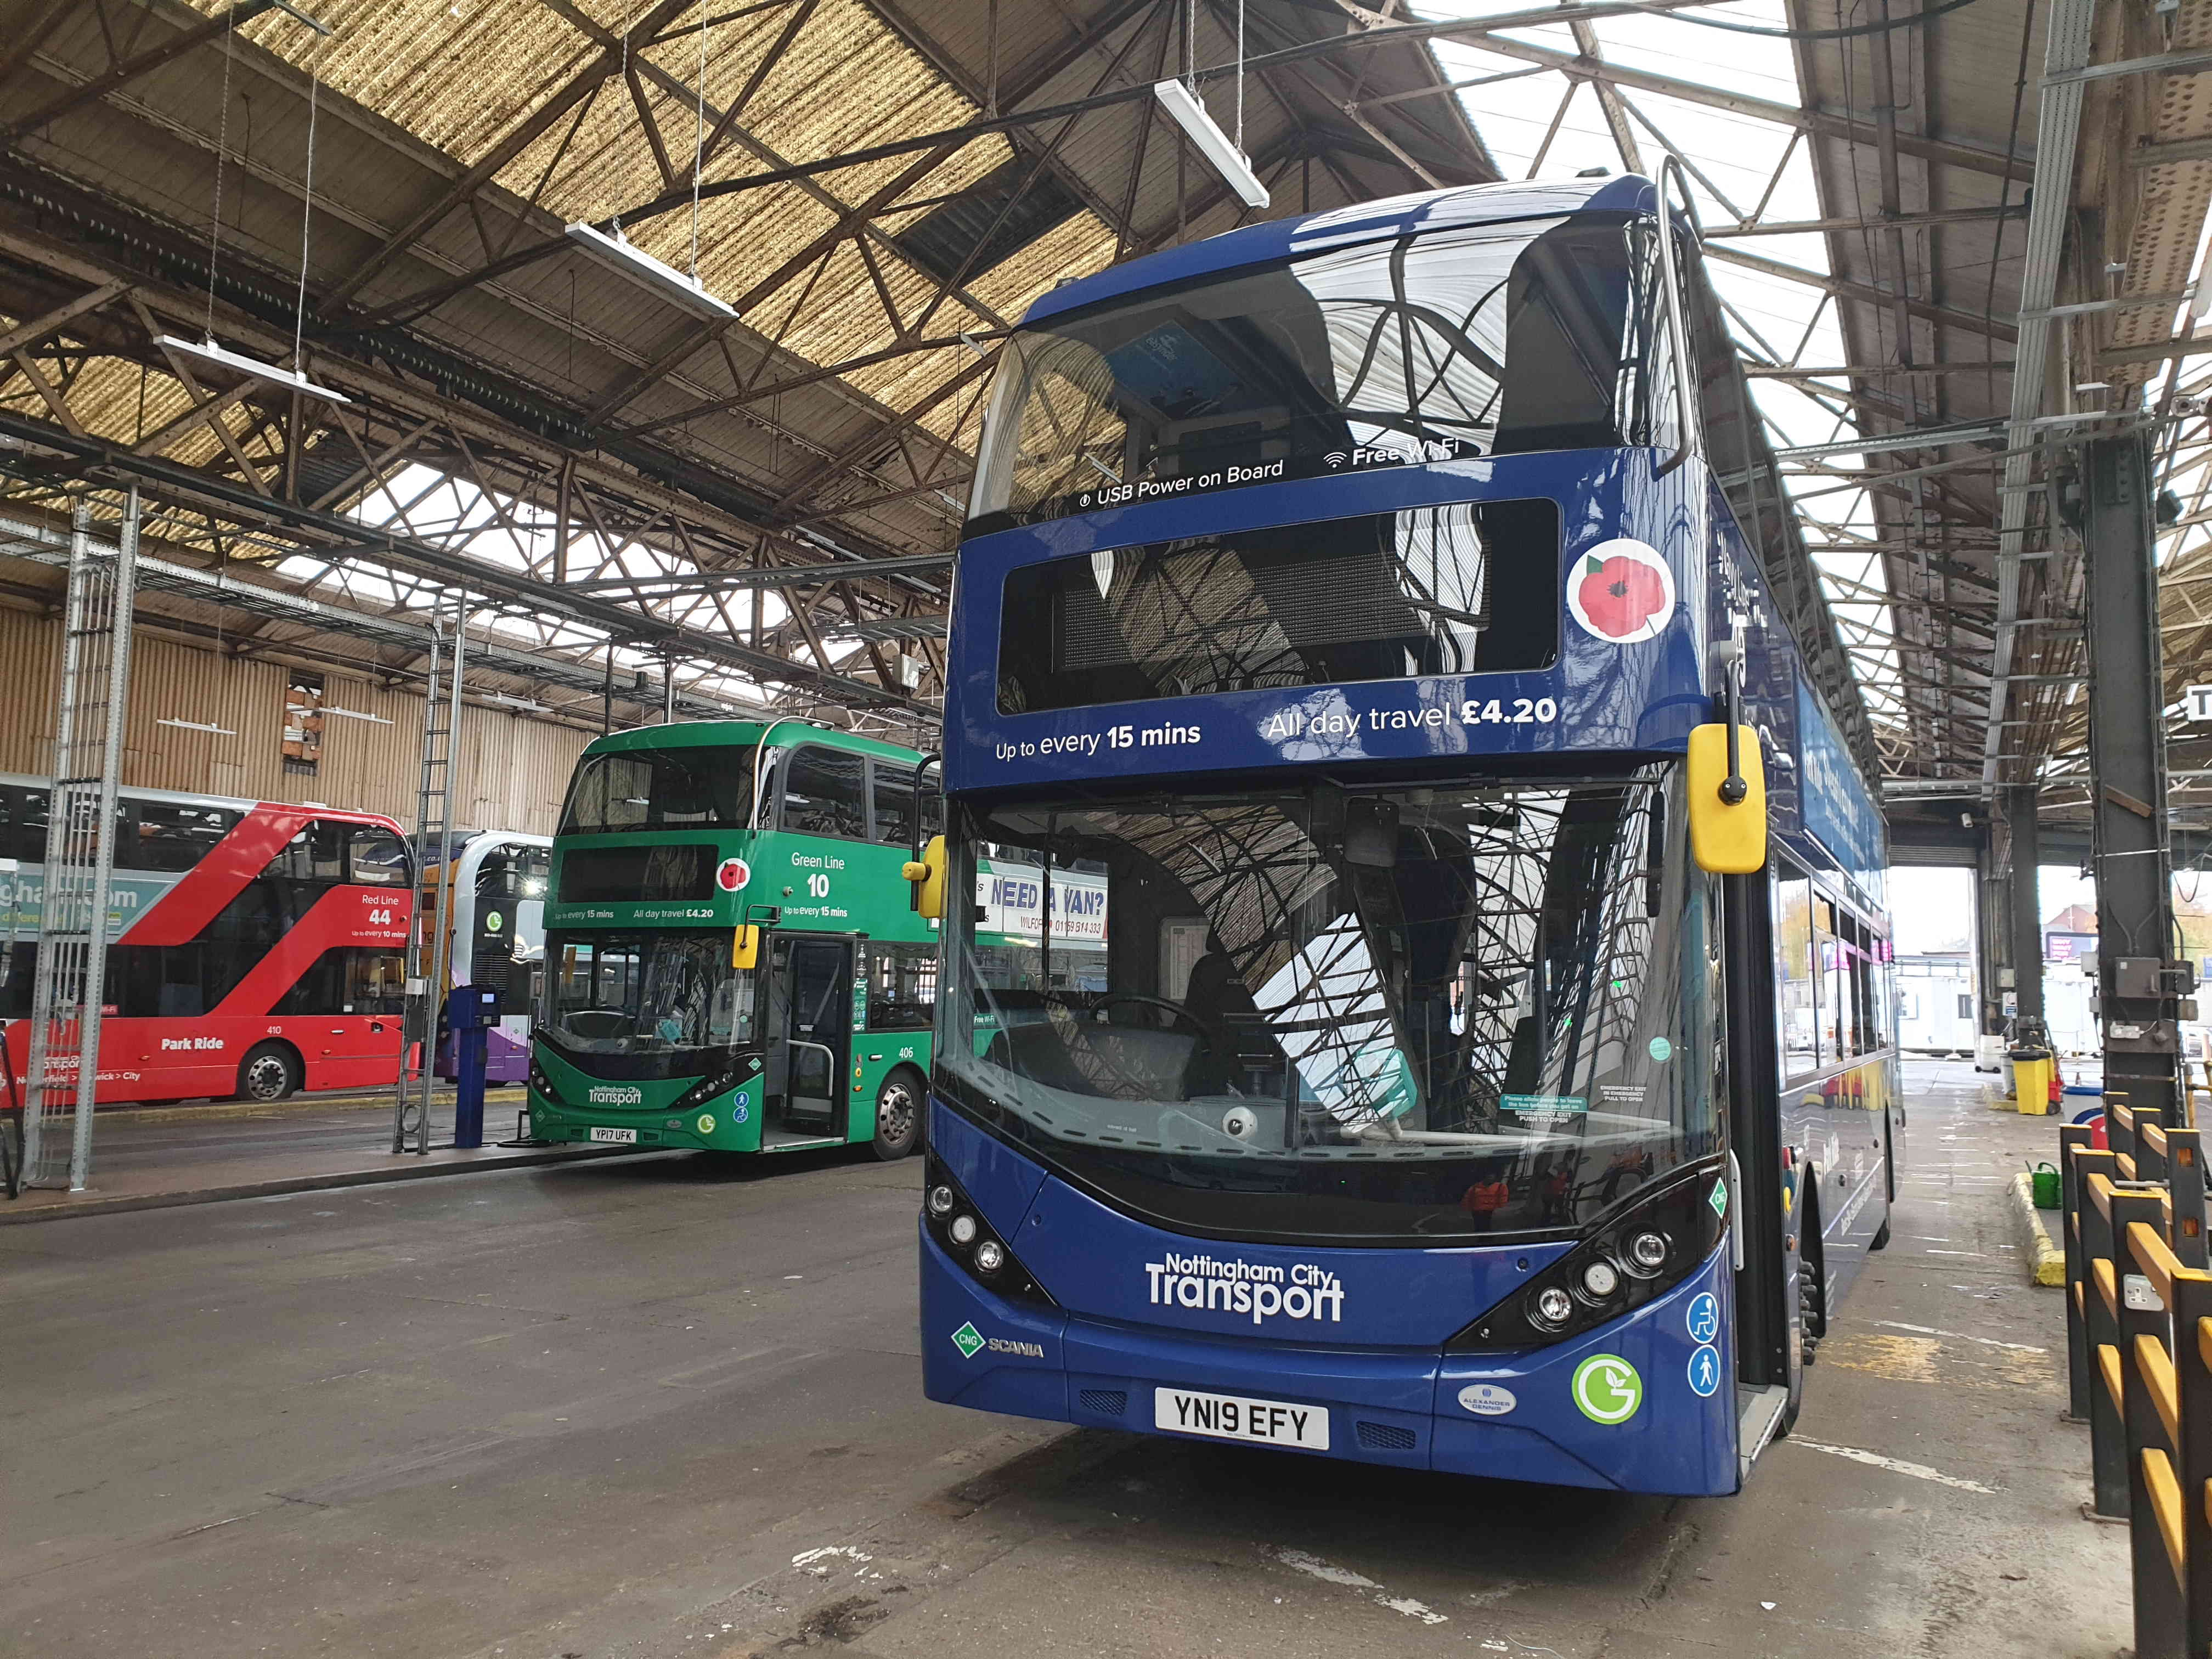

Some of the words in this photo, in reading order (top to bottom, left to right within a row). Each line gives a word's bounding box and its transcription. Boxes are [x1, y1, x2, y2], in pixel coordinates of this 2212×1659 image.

[1353, 447, 1400, 466] Free
[1407, 438, 1460, 457] Wi-Fi
[1097, 486, 1132, 505] USB
[1138, 476, 1194, 498] Power
[1199, 474, 1220, 487] on
[1227, 460, 1283, 484] Board
[1268, 714, 1300, 737] All
[1311, 710, 1359, 738] day
[1369, 702, 1451, 730] travel
[1461, 698, 1557, 725] £4.20
[996, 742, 1016, 762] Up
[1021, 742, 1035, 757] to
[1041, 733, 1101, 756] every
[1107, 725, 1133, 748] 15
[1142, 721, 1200, 746] mins
[792, 852, 822, 867] Green
[825, 855, 844, 869] Line
[808, 873, 829, 898] 10
[362, 895, 379, 904] Red
[381, 895, 399, 905] Line
[991, 879, 1037, 909] NEED
[1065, 889, 1104, 916] VAN?
[369, 909, 391, 925] 44
[568, 912, 586, 920] every
[596, 910, 614, 918] mins
[634, 910, 644, 918] All
[646, 911, 659, 919] day
[662, 909, 685, 917] travel
[686, 909, 714, 918] £4.20
[785, 906, 793, 915] Up
[800, 907, 820, 918] every
[821, 906, 829, 916] 15
[831, 907, 848, 917] mins
[1090, 923, 1101, 934] 333
[267, 1026, 281, 1034] 410
[161, 1038, 191, 1050] Park
[195, 1037, 224, 1049] Ride
[899, 1047, 913, 1059] 406
[122, 1072, 140, 1081] City
[589, 1089, 642, 1106] Transport
[594, 1086, 626, 1094] Nottingham
[596, 1129, 614, 1139] YP17
[616, 1130, 631, 1141] UFK
[1166, 1253, 1285, 1283] Nottingham
[1291, 1264, 1334, 1290] City
[1146, 1263, 1344, 1324] Transport
[959, 1334, 977, 1346] CNG
[988, 1338, 1043, 1357] SCANIA
[1464, 1398, 1510, 1407] ALEXANDER
[1174, 1396, 1239, 1432] YN19
[1249, 1405, 1308, 1441] EFY
